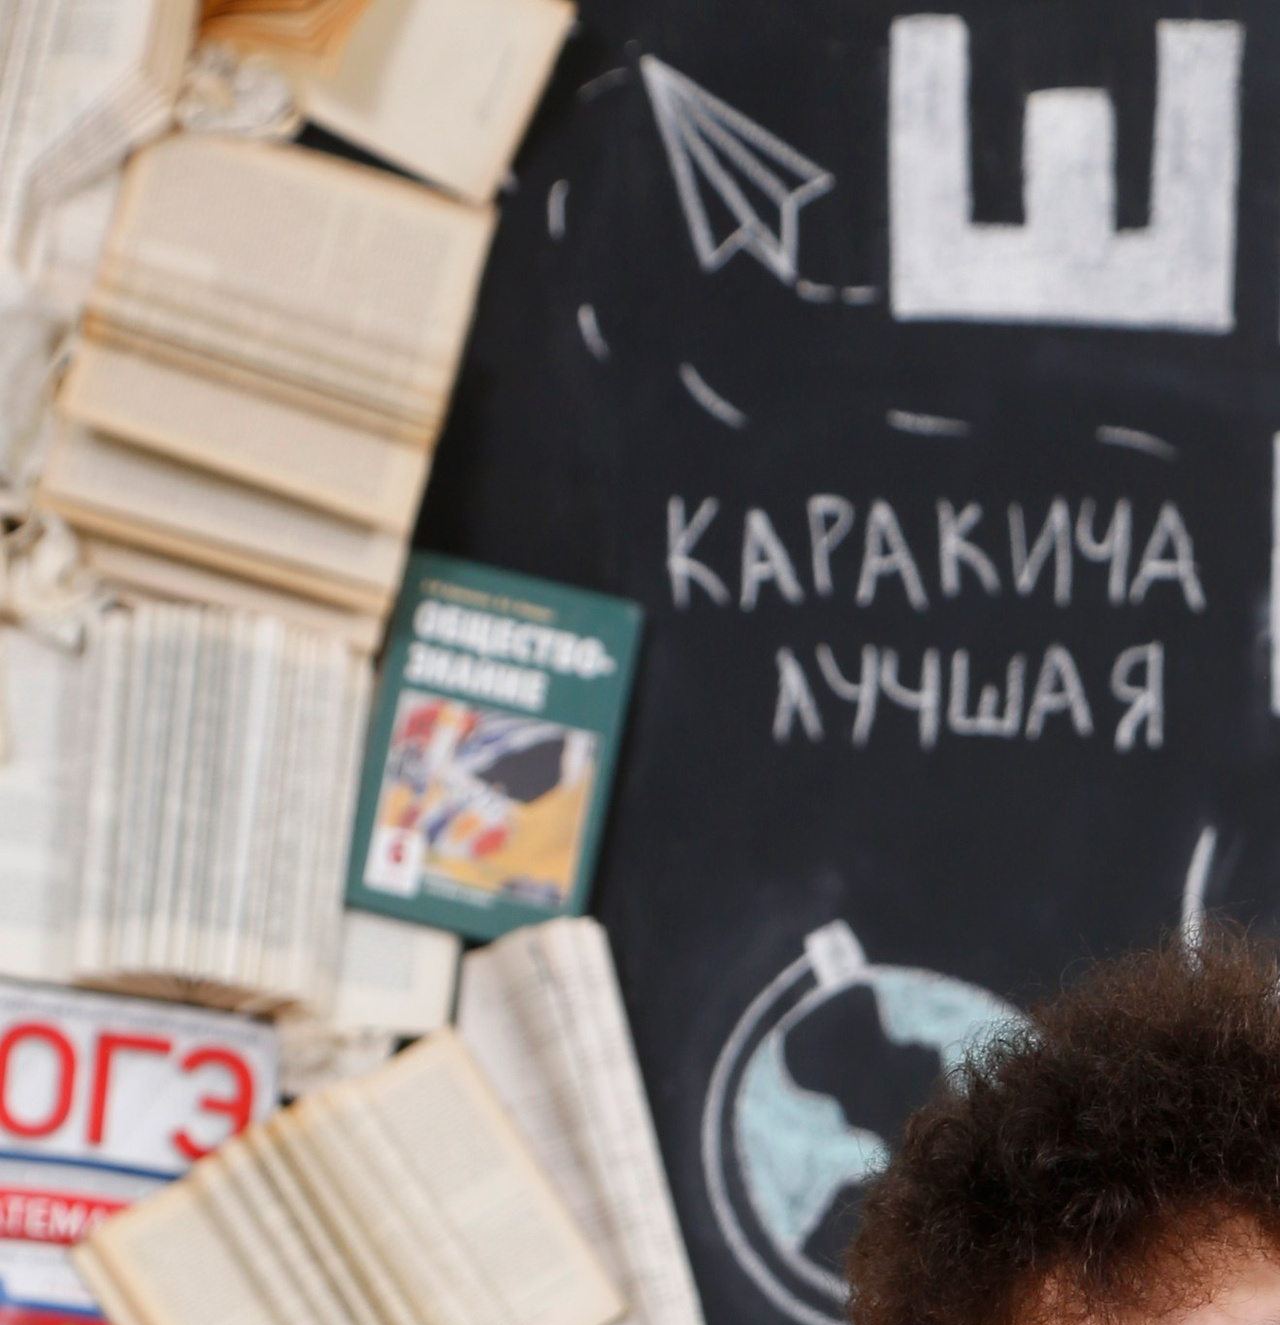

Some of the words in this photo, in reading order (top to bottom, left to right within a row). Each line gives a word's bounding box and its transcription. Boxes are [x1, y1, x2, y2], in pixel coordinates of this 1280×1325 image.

[666, 494, 1206, 611] КАРАКИЧА
[773, 640, 1166, 749] ЛУЧШАЯ
[0, 1021, 256, 1164] ОГЭ
